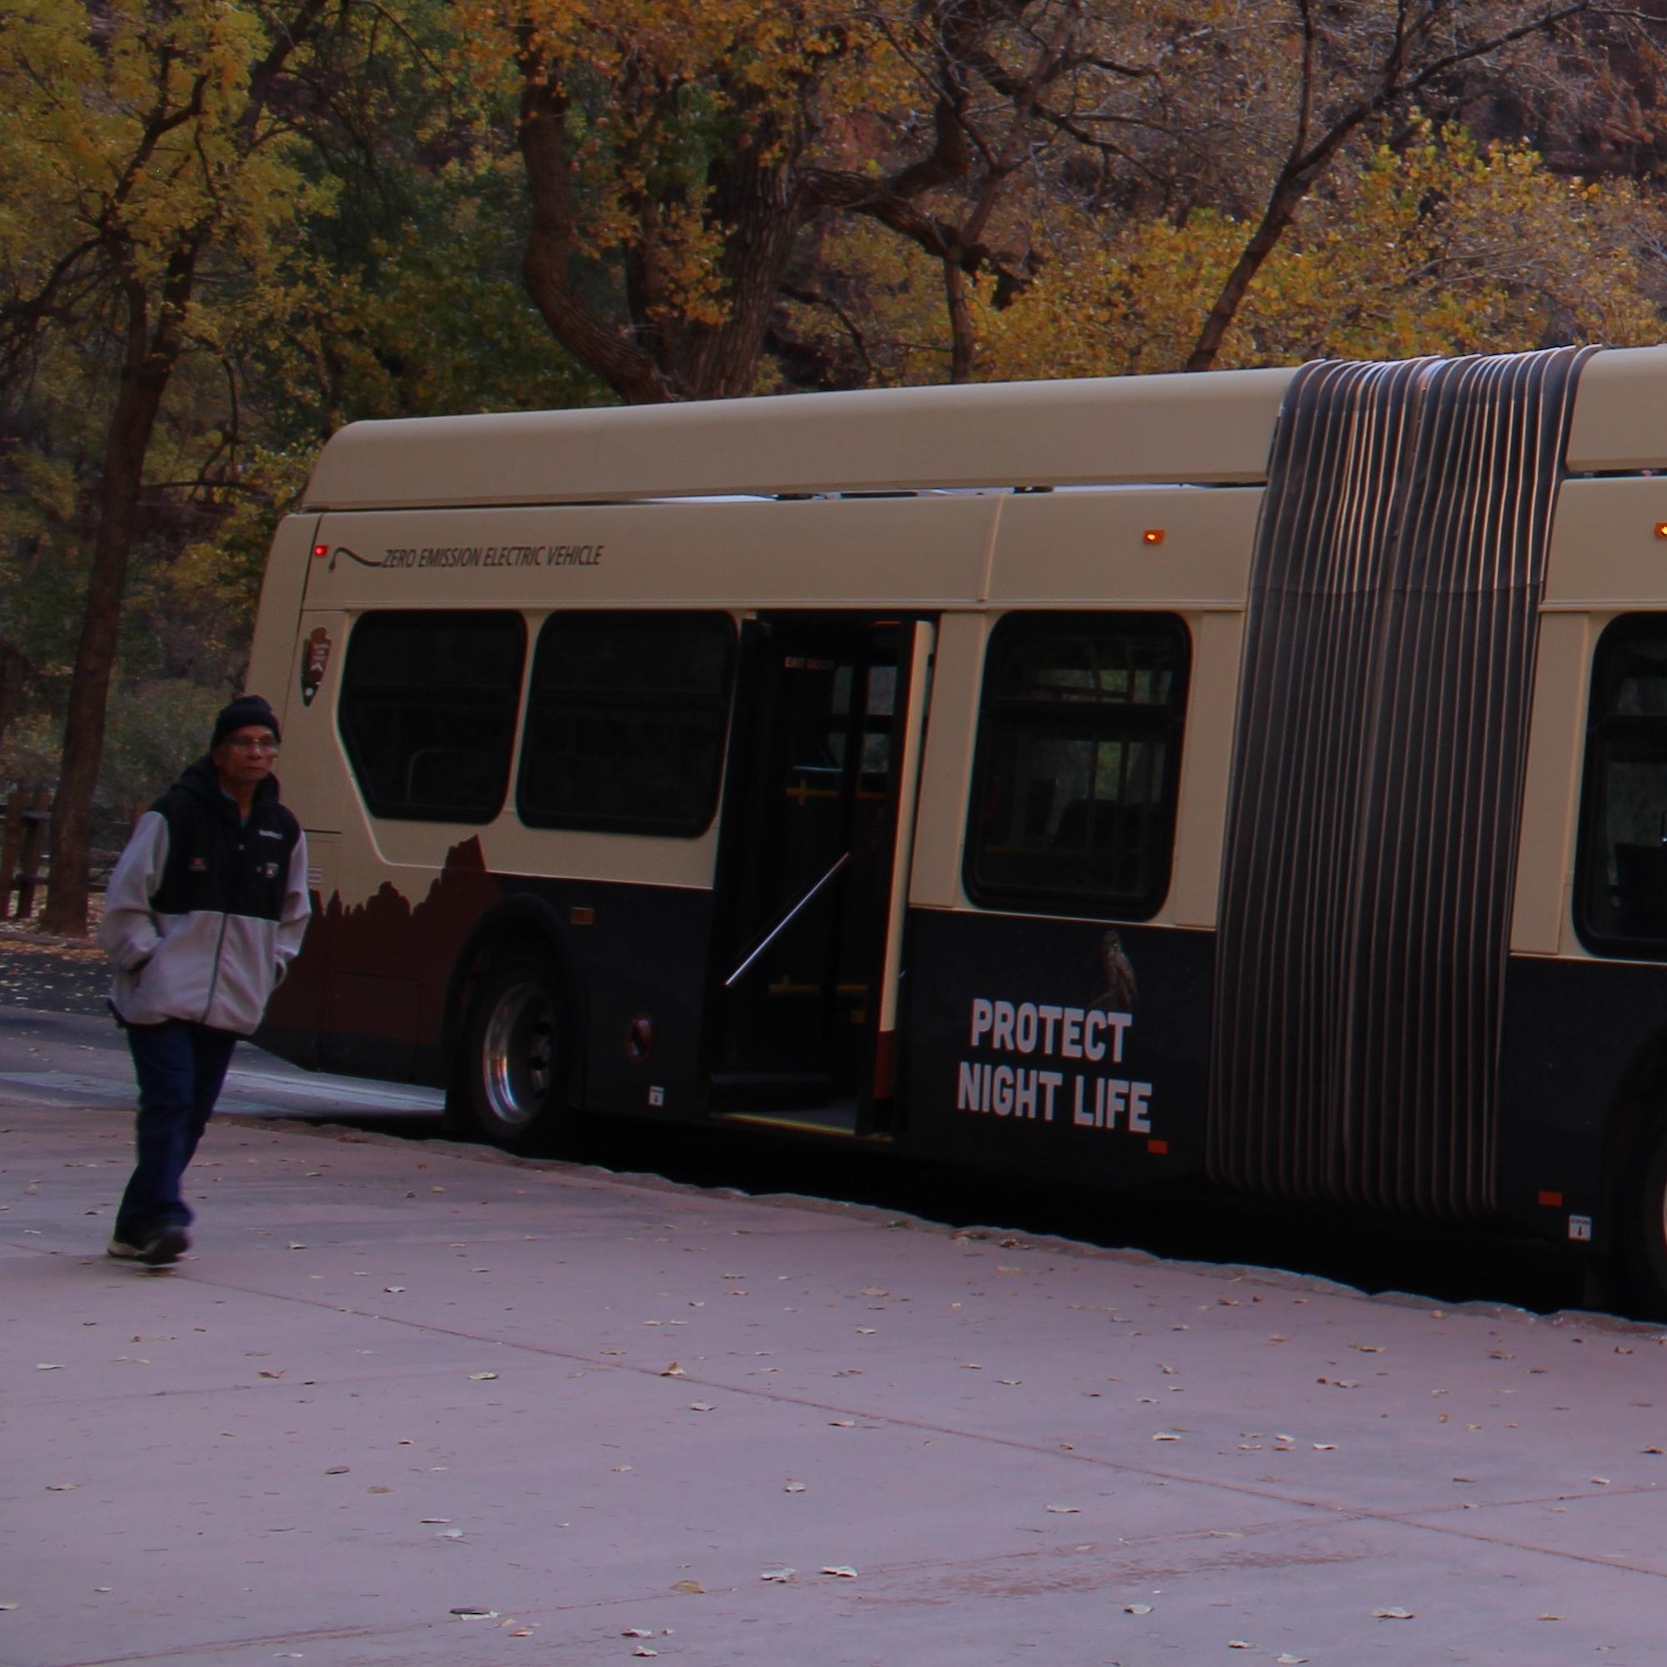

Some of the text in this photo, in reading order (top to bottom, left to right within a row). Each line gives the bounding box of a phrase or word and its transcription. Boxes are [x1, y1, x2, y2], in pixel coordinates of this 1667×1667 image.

[382, 545, 604, 568] ZERO EMISSION ELECTRIC VEHICLE
[971, 998, 1133, 1063] PROTECT
[957, 1061, 1153, 1134] NIGHT LIFE
